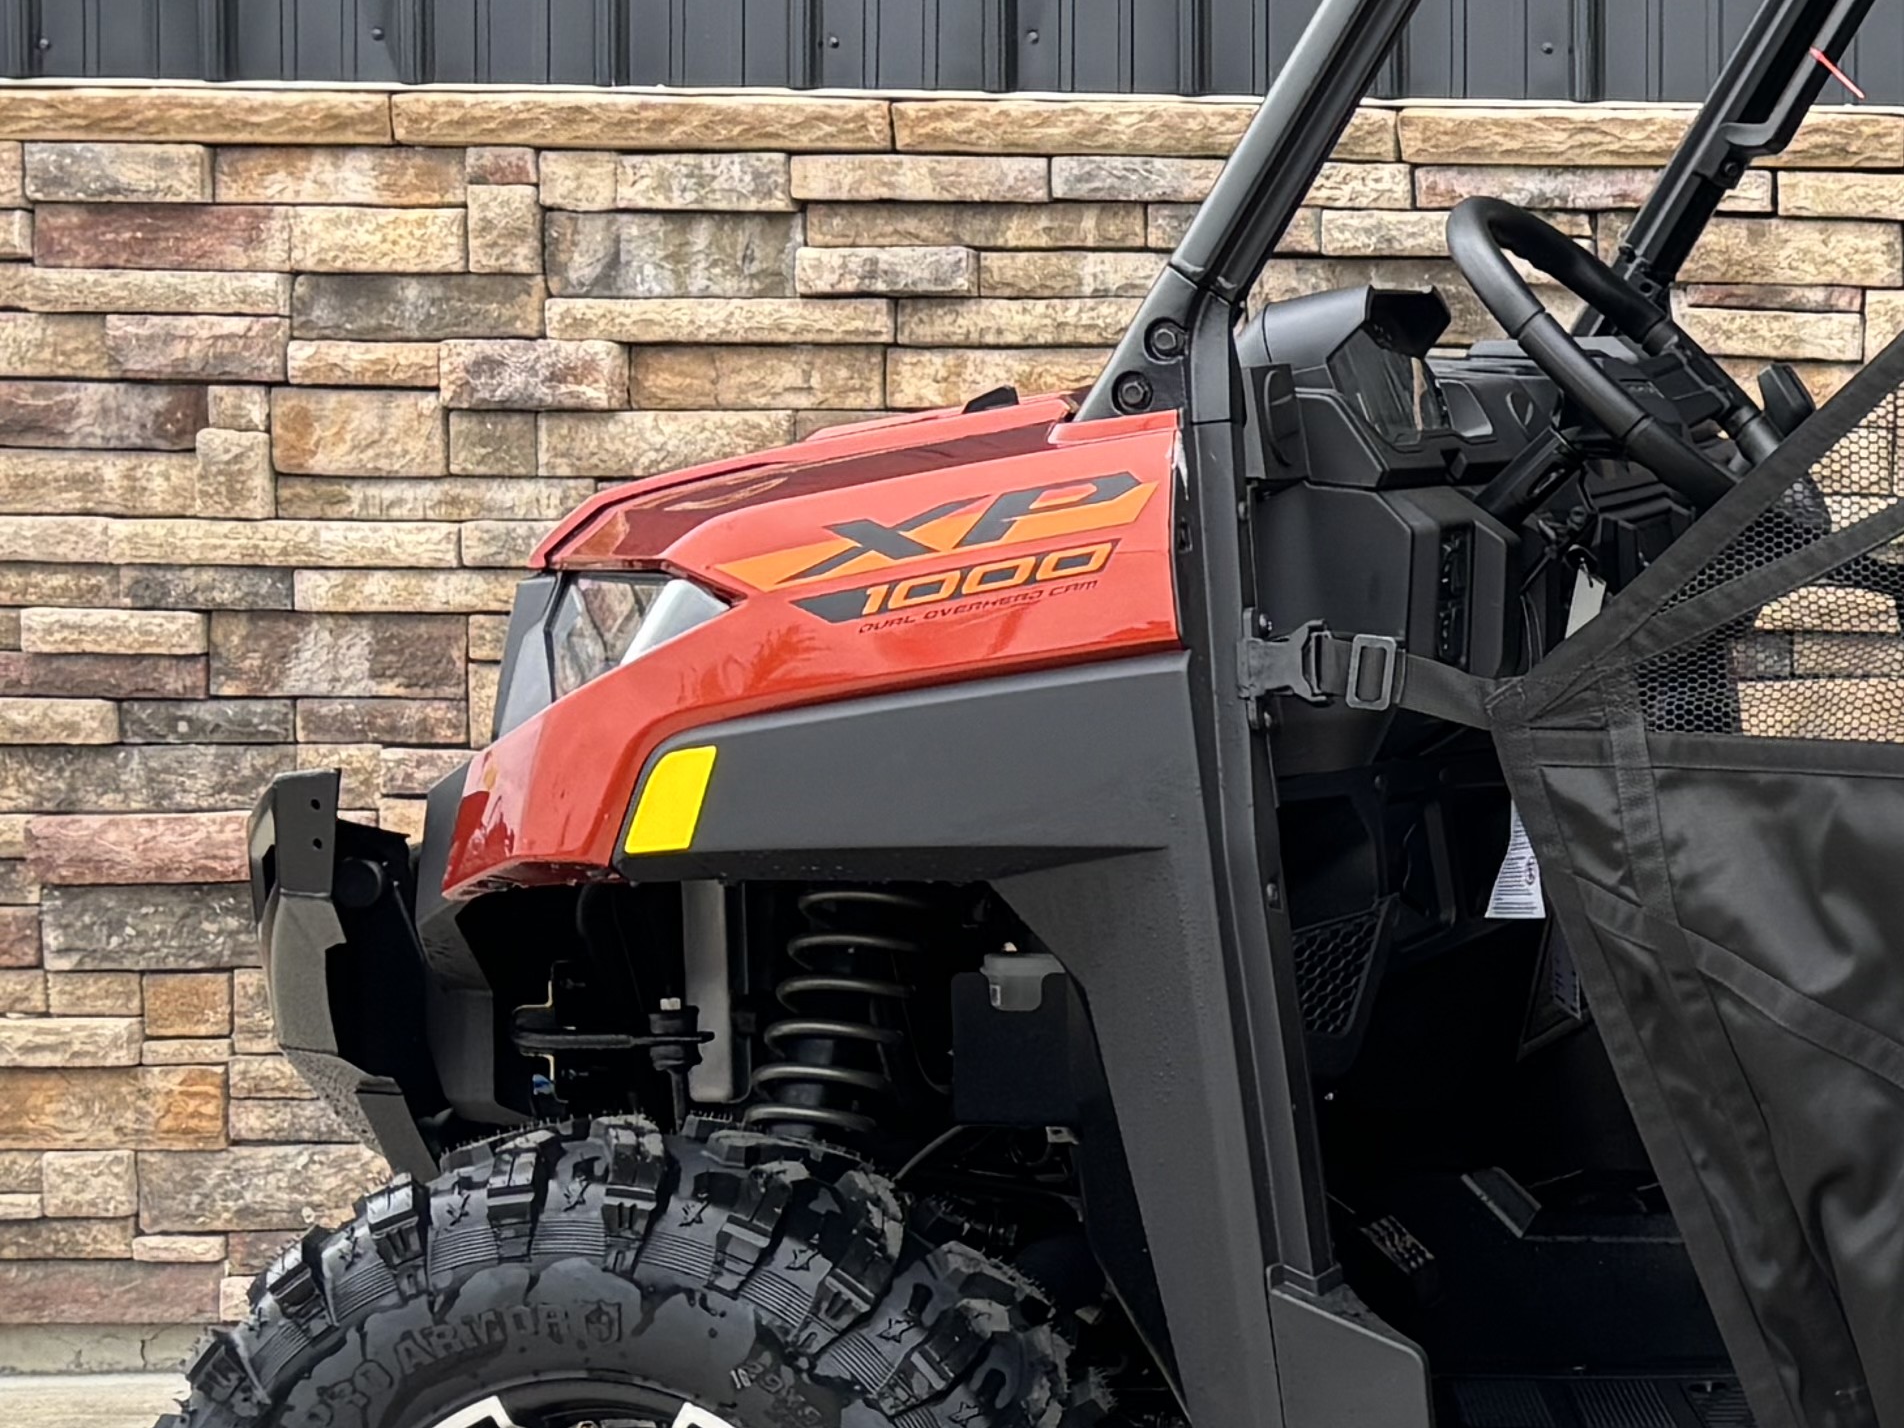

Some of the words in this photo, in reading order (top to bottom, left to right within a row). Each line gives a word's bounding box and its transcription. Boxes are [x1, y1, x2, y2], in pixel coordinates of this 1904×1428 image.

[774, 470, 1143, 585] XP
[858, 616, 915, 634] DUAL
[1049, 579, 1099, 597] CAM
[861, 542, 1114, 616] 1000
